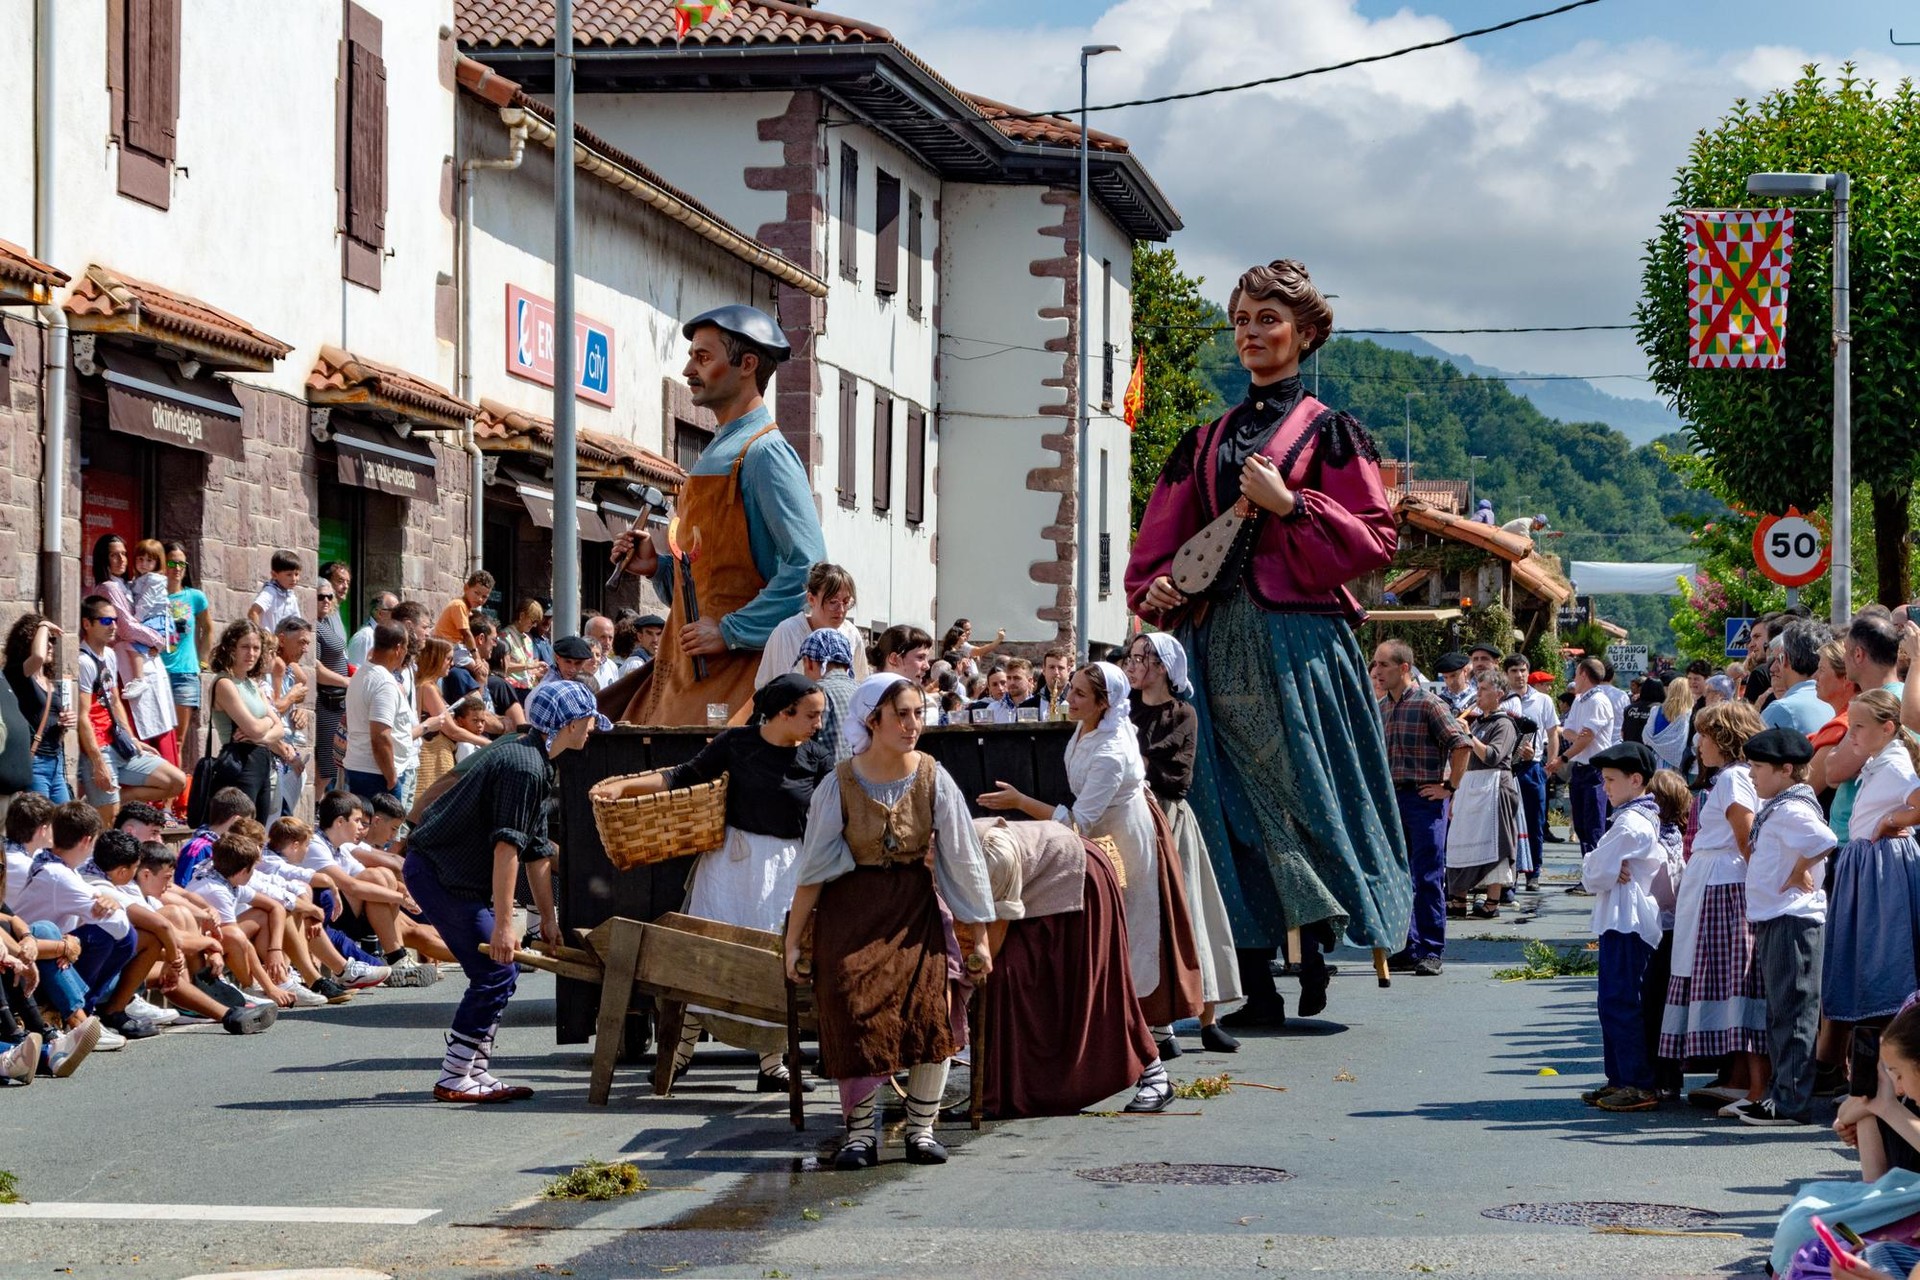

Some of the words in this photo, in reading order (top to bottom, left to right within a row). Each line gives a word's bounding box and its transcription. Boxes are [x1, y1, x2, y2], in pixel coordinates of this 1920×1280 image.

[588, 343, 605, 390] city
[152, 401, 203, 444] okindegia
[1772, 532, 1816, 558] 50
